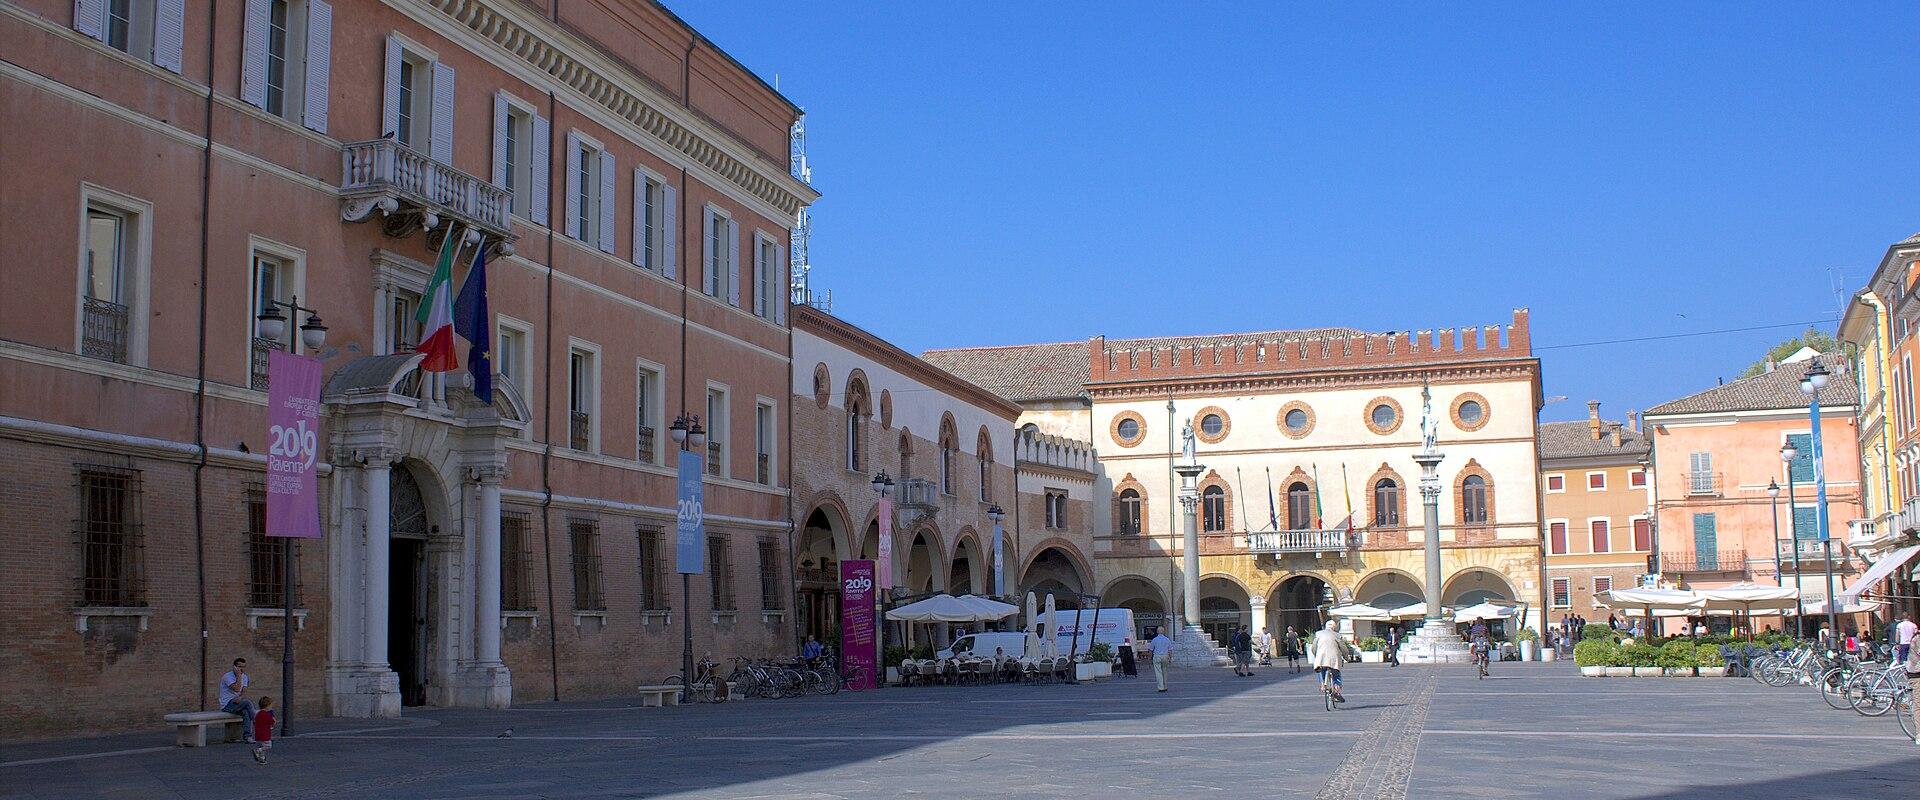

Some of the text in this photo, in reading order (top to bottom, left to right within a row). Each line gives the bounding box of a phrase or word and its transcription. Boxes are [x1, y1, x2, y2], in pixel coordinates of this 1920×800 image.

[270, 419, 317, 470] 2019
[269, 455, 304, 474] Ravenna
[678, 495, 702, 528] 2019
[845, 576, 872, 592] 2019
